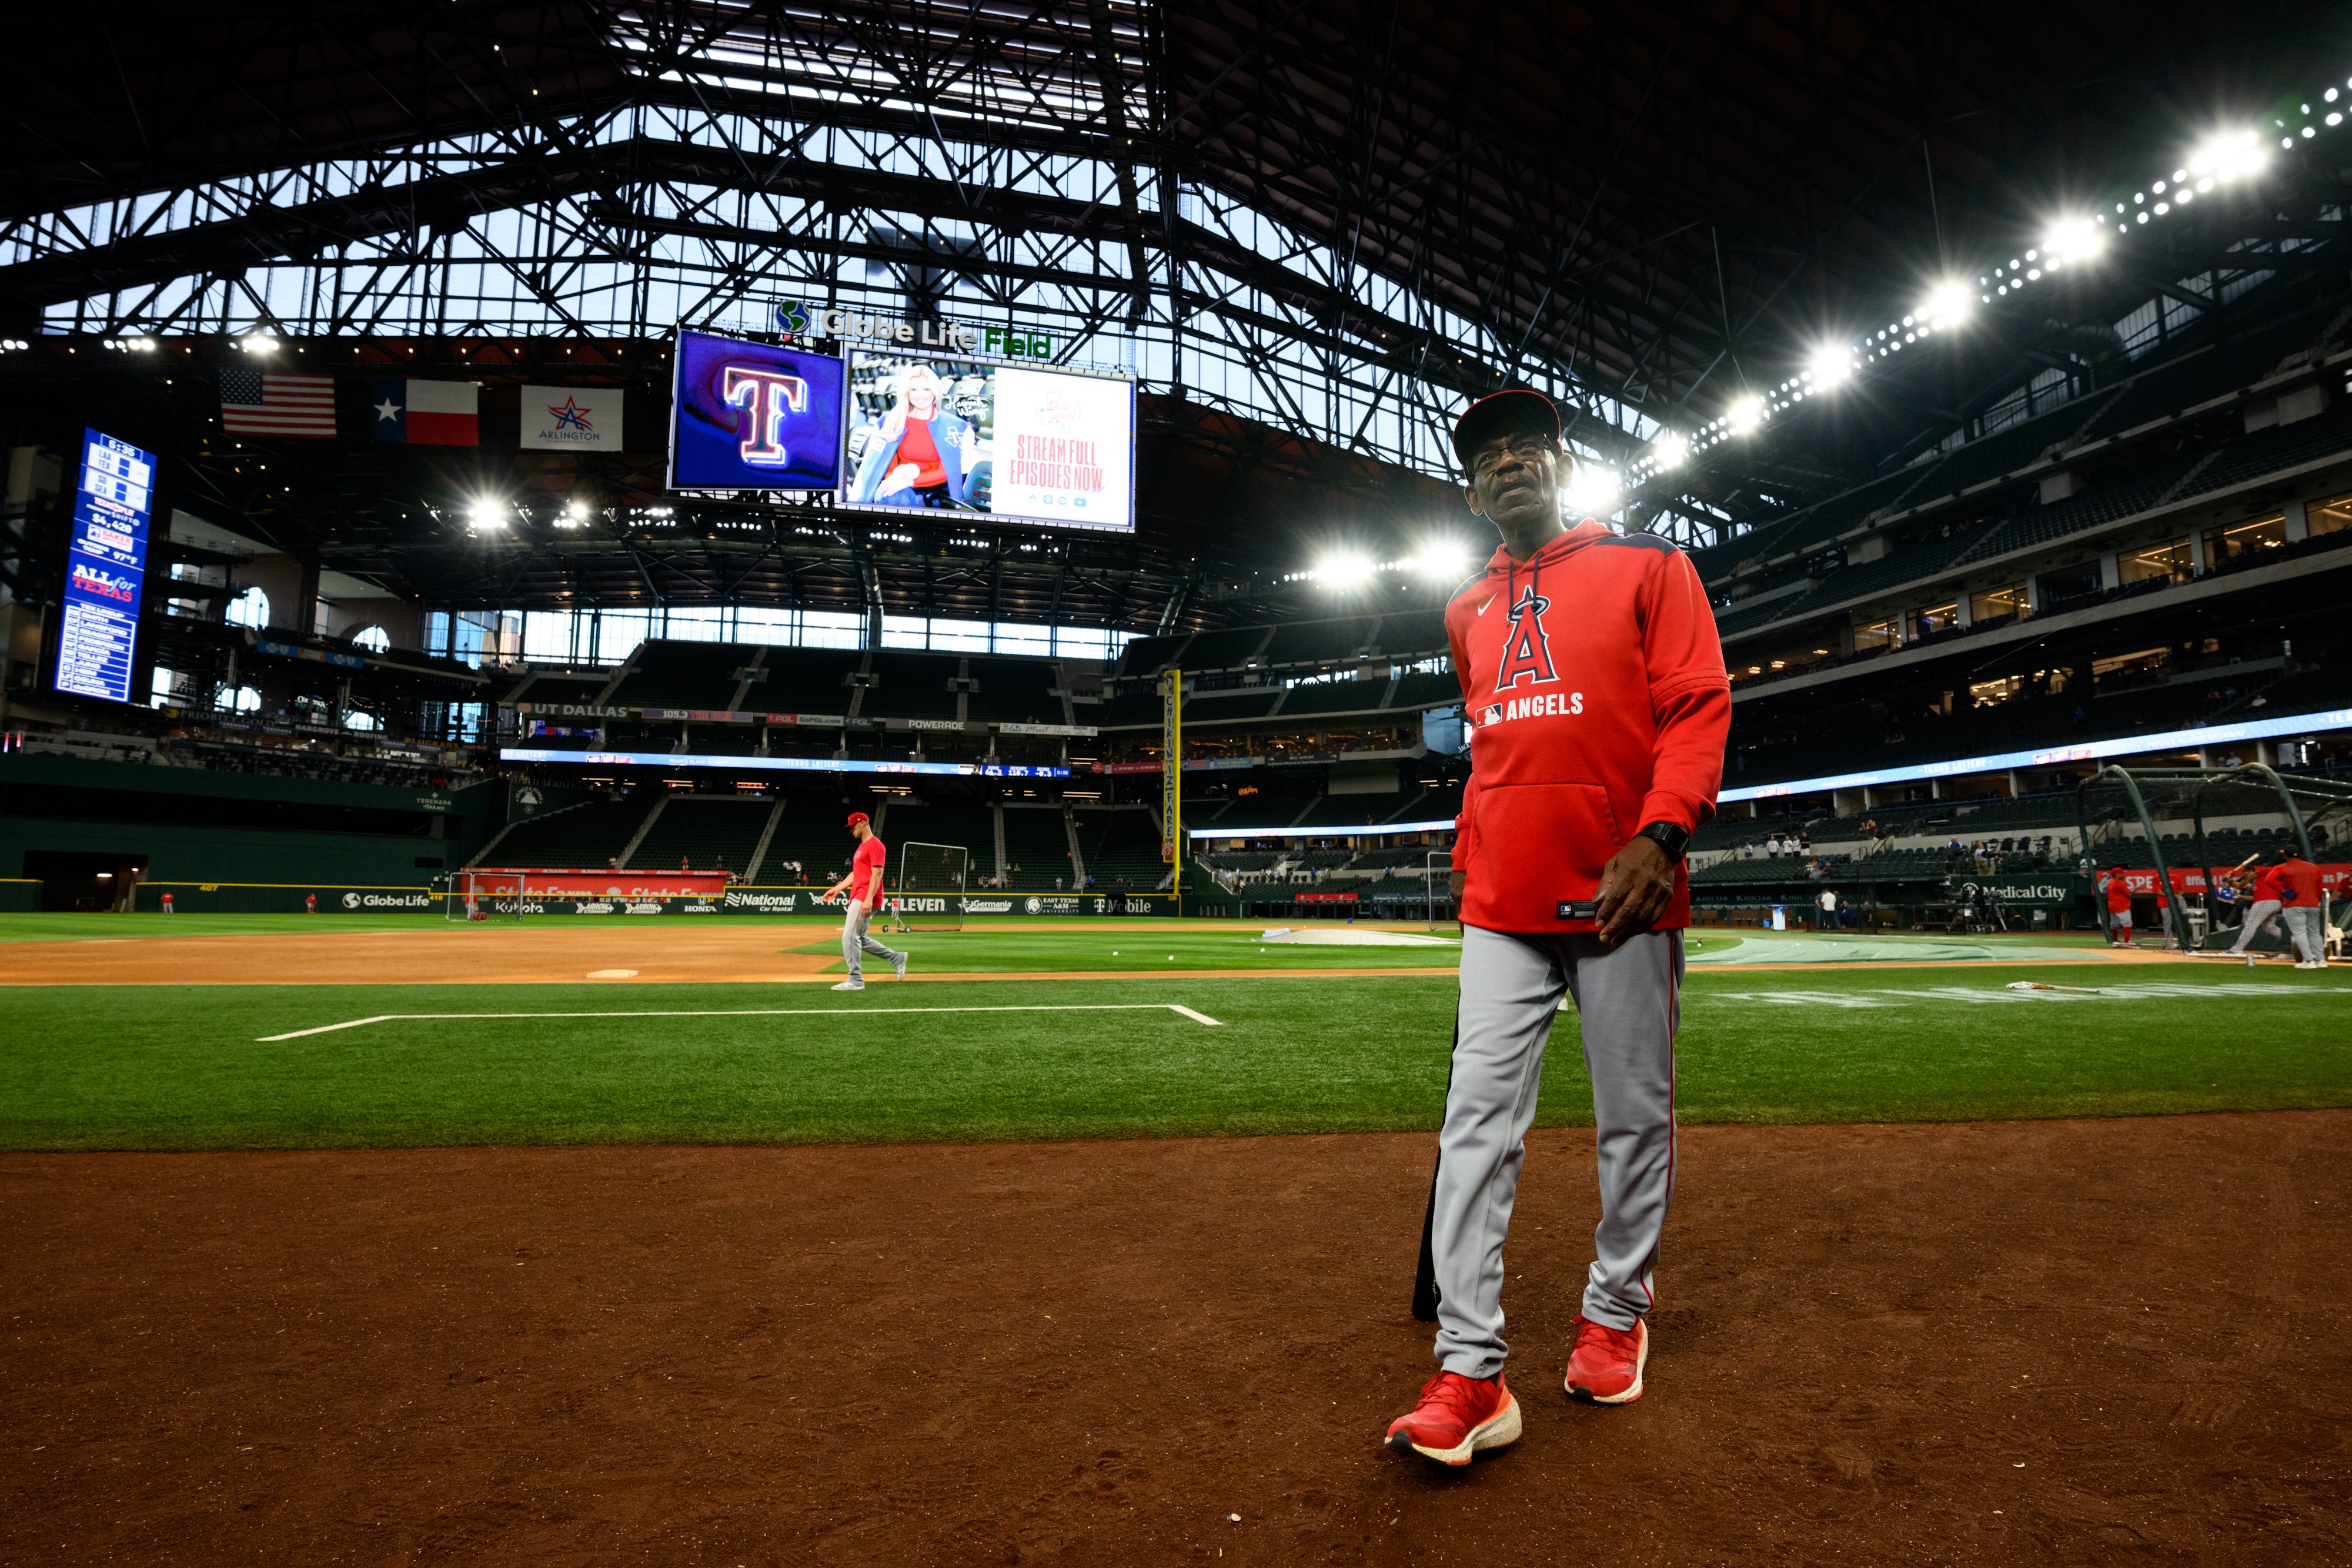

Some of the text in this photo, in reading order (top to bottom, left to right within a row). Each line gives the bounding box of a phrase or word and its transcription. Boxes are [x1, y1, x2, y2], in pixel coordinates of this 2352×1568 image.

[821, 309, 1051, 358] Globe Life Field
[723, 367, 809, 467] T
[539, 430, 600, 441] ARLINGTON
[108, 439, 135, 457] 5:35
[1017, 434, 1097, 466] STREAM FULL
[1010, 459, 1104, 493] EPISODES NOW
[102, 530, 131, 543] BAKER
[72, 564, 137, 593] ALL for
[72, 576, 133, 601] TEXAS
[534, 704, 559, 714] UT
[563, 705, 627, 717] DALLAS
[663, 710, 731, 720] 105.3 THE FAN
[1505, 692, 1584, 721] ANGELS
[181, 709, 275, 727] PRIORITY GOLD
[908, 720, 964, 730] POWERADE
[295, 724, 388, 741] HARGROVE ROOFING
[1165, 696, 1174, 759] CHIKIN
[1923, 758, 1987, 774] TEXAS LOTTERY
[416, 798, 452, 806] TEREMANA
[363, 894, 429, 908] Globe Life
[741, 894, 795, 906] National
[2036, 885, 2067, 901] City
